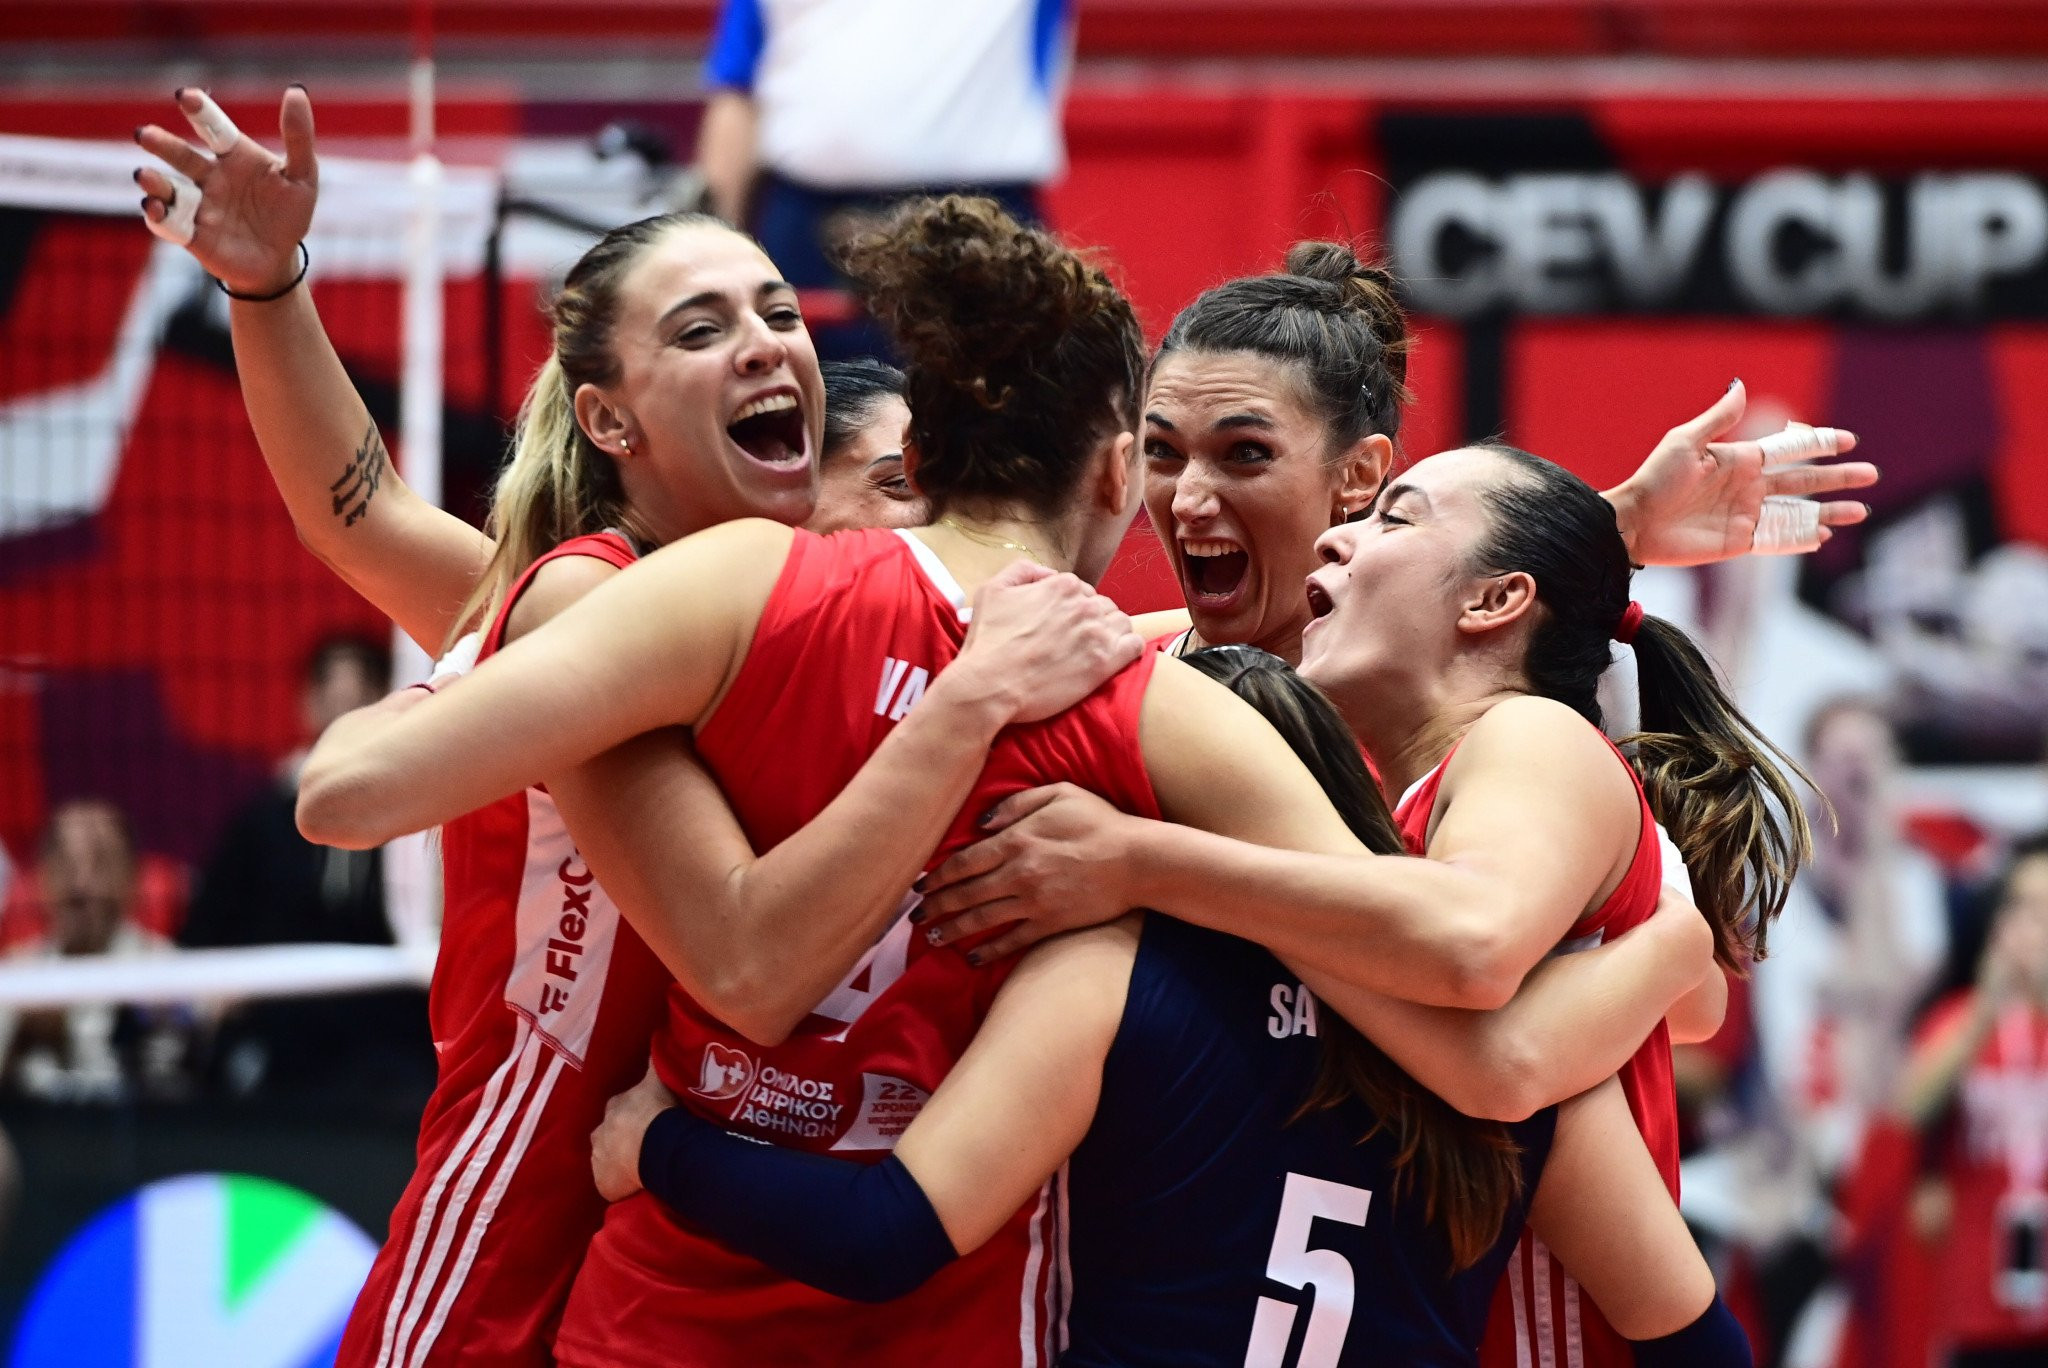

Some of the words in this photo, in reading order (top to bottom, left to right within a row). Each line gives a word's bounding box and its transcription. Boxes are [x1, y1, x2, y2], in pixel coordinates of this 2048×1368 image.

[1390, 172, 1714, 310] CEV
[1722, 168, 2048, 312] CUP
[873, 656, 929, 721] VA
[546, 847, 594, 982] FlexC
[1267, 983, 1318, 1039] SA
[741, 1103, 837, 1138] ΑΘΗΝΩΝ
[879, 1082, 918, 1100] 22
[1243, 1171, 1373, 1368] 5
